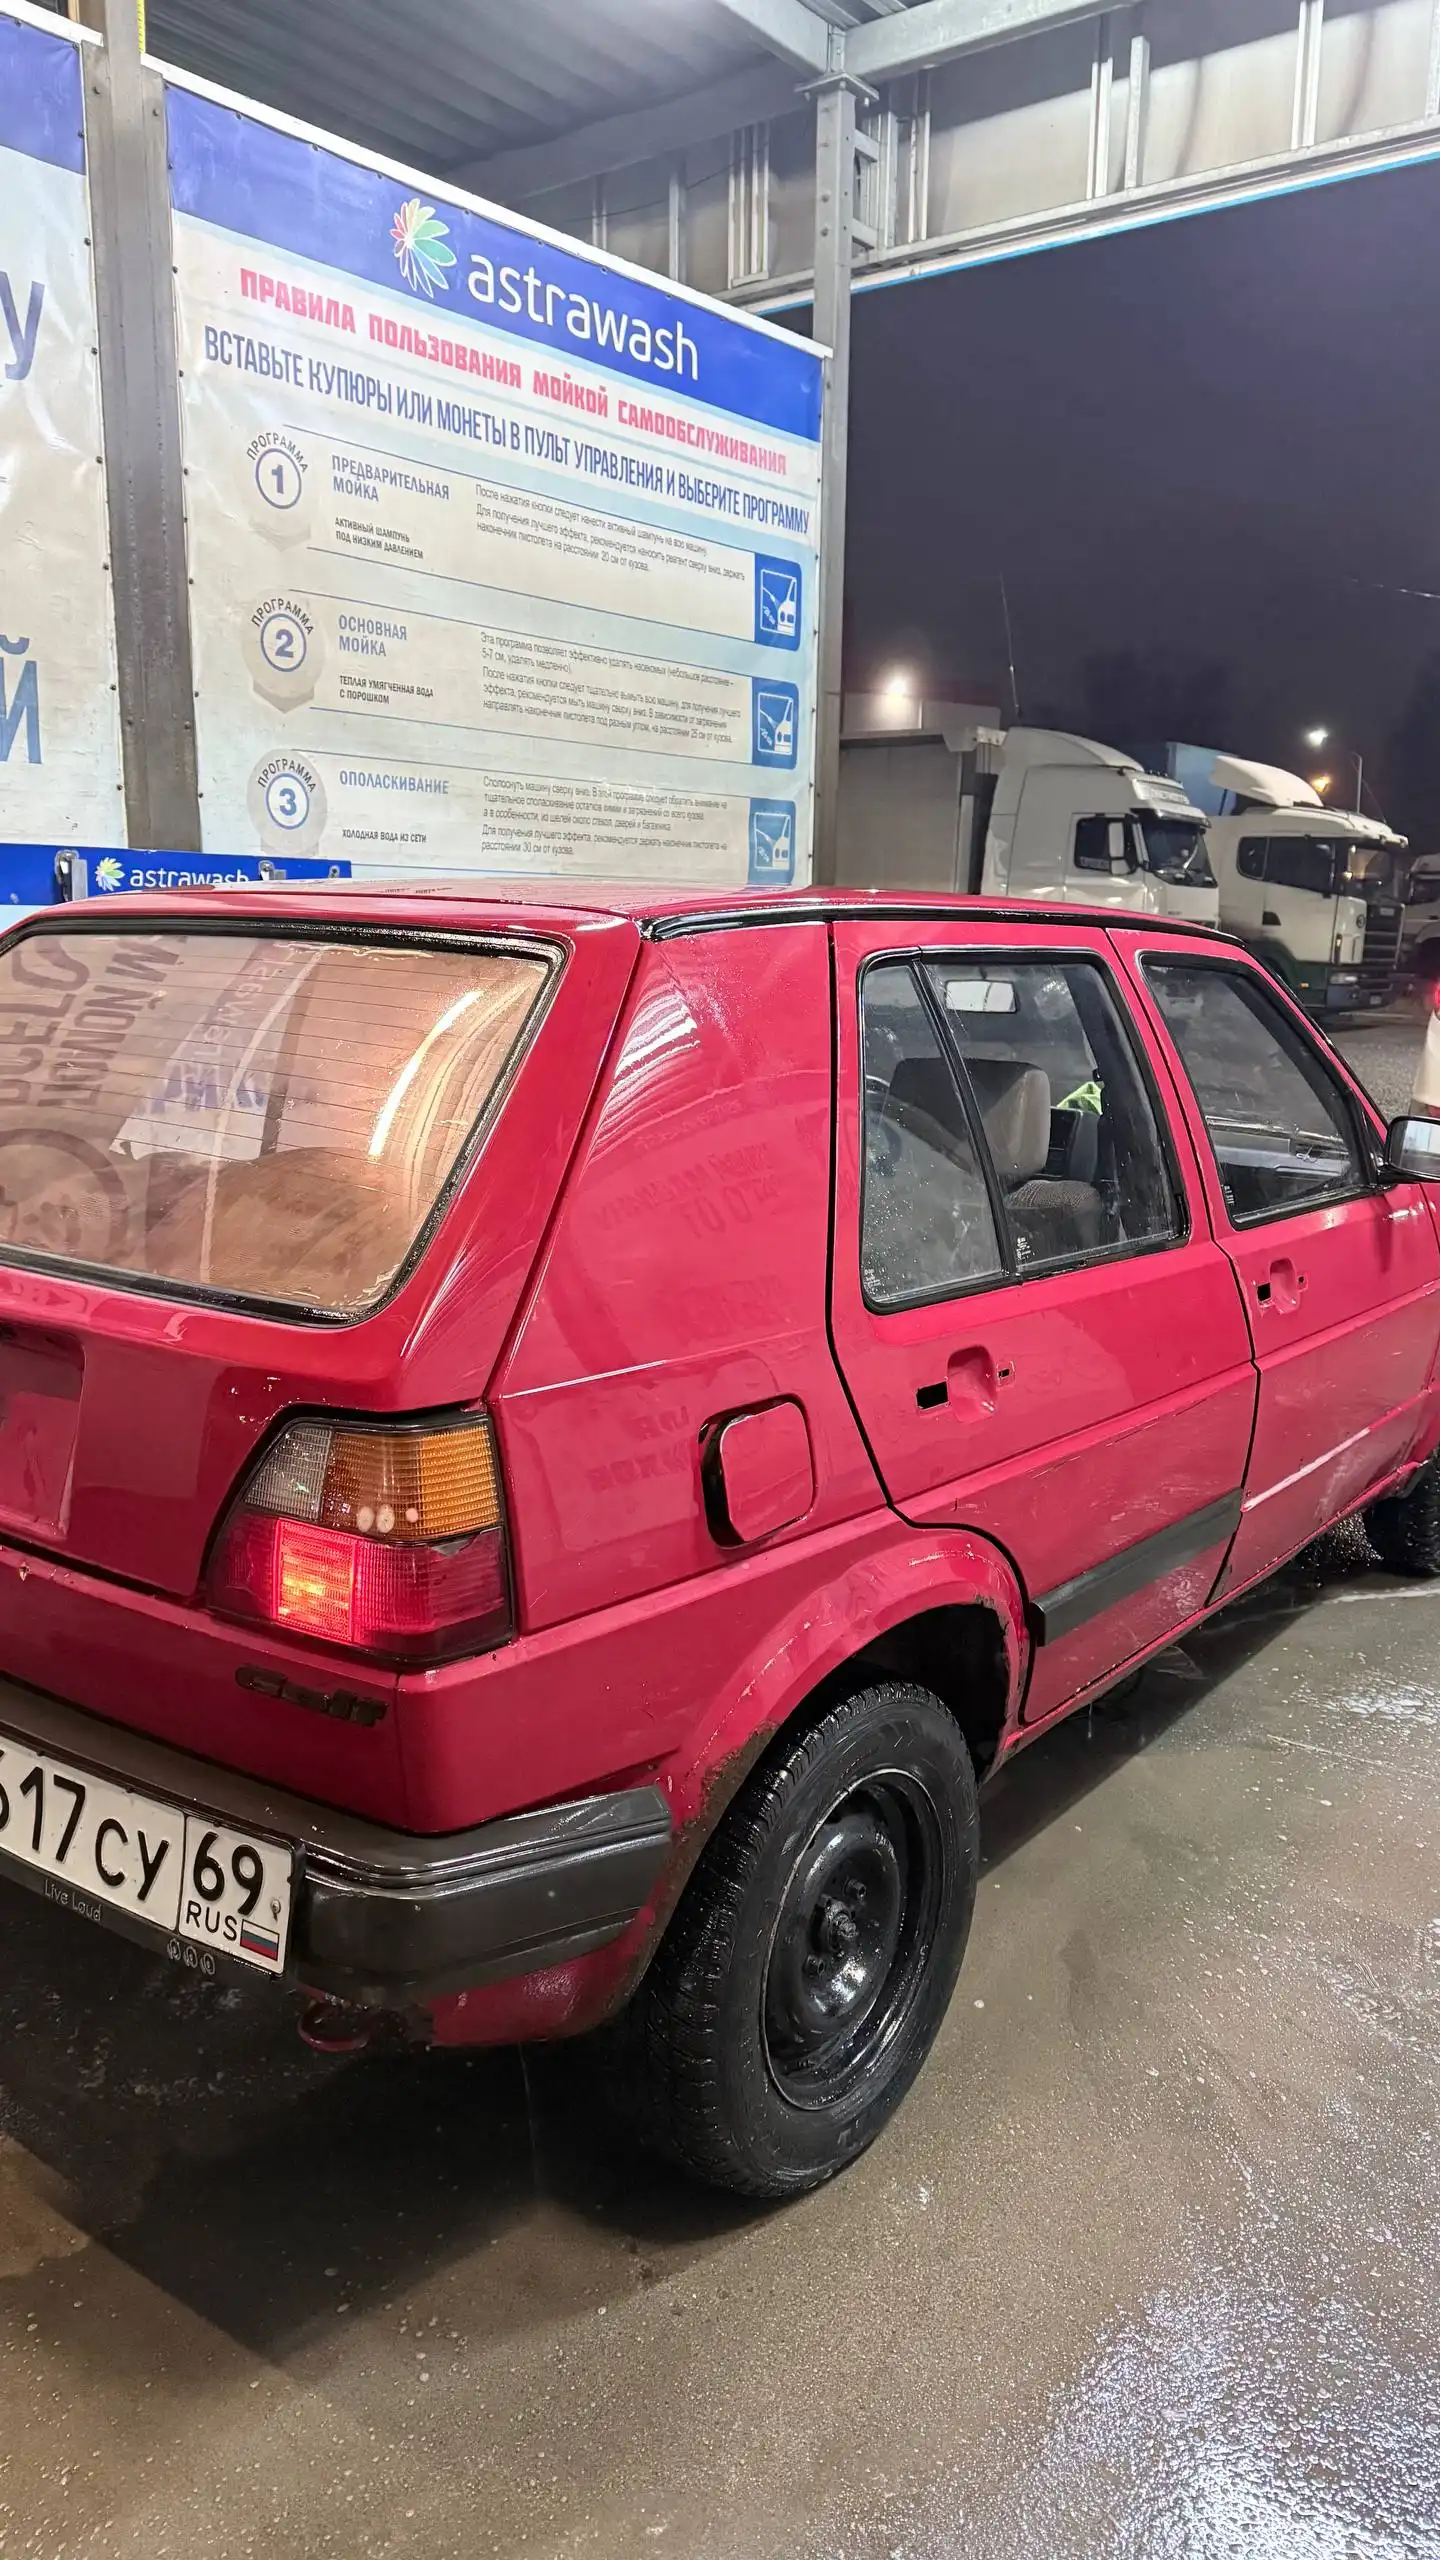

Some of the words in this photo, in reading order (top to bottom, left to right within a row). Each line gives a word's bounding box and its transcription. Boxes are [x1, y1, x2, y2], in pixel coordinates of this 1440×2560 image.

[468, 254, 699, 380] astrawash
[240, 268, 356, 333] ПРАВИЛА
[369, 313, 522, 389] ПОЛЬЗОВАНИЯ
[533, 370, 609, 418] МОЙКОЙ
[618, 400, 787, 476] САМООБСЛУЖИВАНИЯ
[204, 325, 304, 387] ВСТАВЬТЕ
[309, 358, 392, 414] КУПЮРЫ
[396, 386, 432, 423] ИЛИ
[437, 399, 506, 447] МОНЕТЫ
[510, 422, 520, 447] В
[525, 425, 571, 464] ПУЛЬТ
[575, 442, 663, 495] УПРАВЛЕНИЯ
[667, 470, 675, 496] И
[678, 475, 740, 517] ВЫБЕРИТЕ
[743, 492, 810, 535] ПРОГРАММУ
[247, 432, 308, 473] ПРОГРАММА
[272, 464, 284, 494] 1
[332, 455, 450, 500] ПРЕДВАРИТЕЛЬНАЯ
[335, 517, 373, 535] АКТИВНЫЙ
[375, 527, 410, 543] ШАМПУНЬ
[336, 530, 351, 544] ПОД
[352, 534, 383, 551] НИЗКИМ
[384, 541, 423, 560] ДАВЛЕНИЕМ
[251, 598, 314, 635] ПРОГРАММА
[339, 614, 407, 640] ОСНОВНАЯ
[275, 629, 294, 659] 2
[339, 635, 387, 657] МОЙКА
[339, 675, 367, 688] ТЕПЛАЯ
[368, 679, 415, 695] УМЯГЧЕННАЯ
[416, 686, 434, 697] ВОДА
[339, 689, 345, 698] С
[346, 690, 390, 704] ПОРОШКОМ
[257, 758, 317, 793] ПРОГРАММА
[339, 770, 449, 795] ОПОЛАСКИВАНИЕ
[279, 788, 297, 816] 3
[342, 829, 379, 841] ХОЛОДНАЯ
[381, 831, 398, 842] ВОДА
[400, 832, 409, 842] ИЗ
[410, 833, 427, 844] СЕТИ
[129, 868, 250, 888] astrawash
[193, 1830, 264, 1917] 69
[43, 1879, 69, 1905] Live
[72, 1893, 102, 1922] Loud
[186, 1900, 238, 1942] RUS
